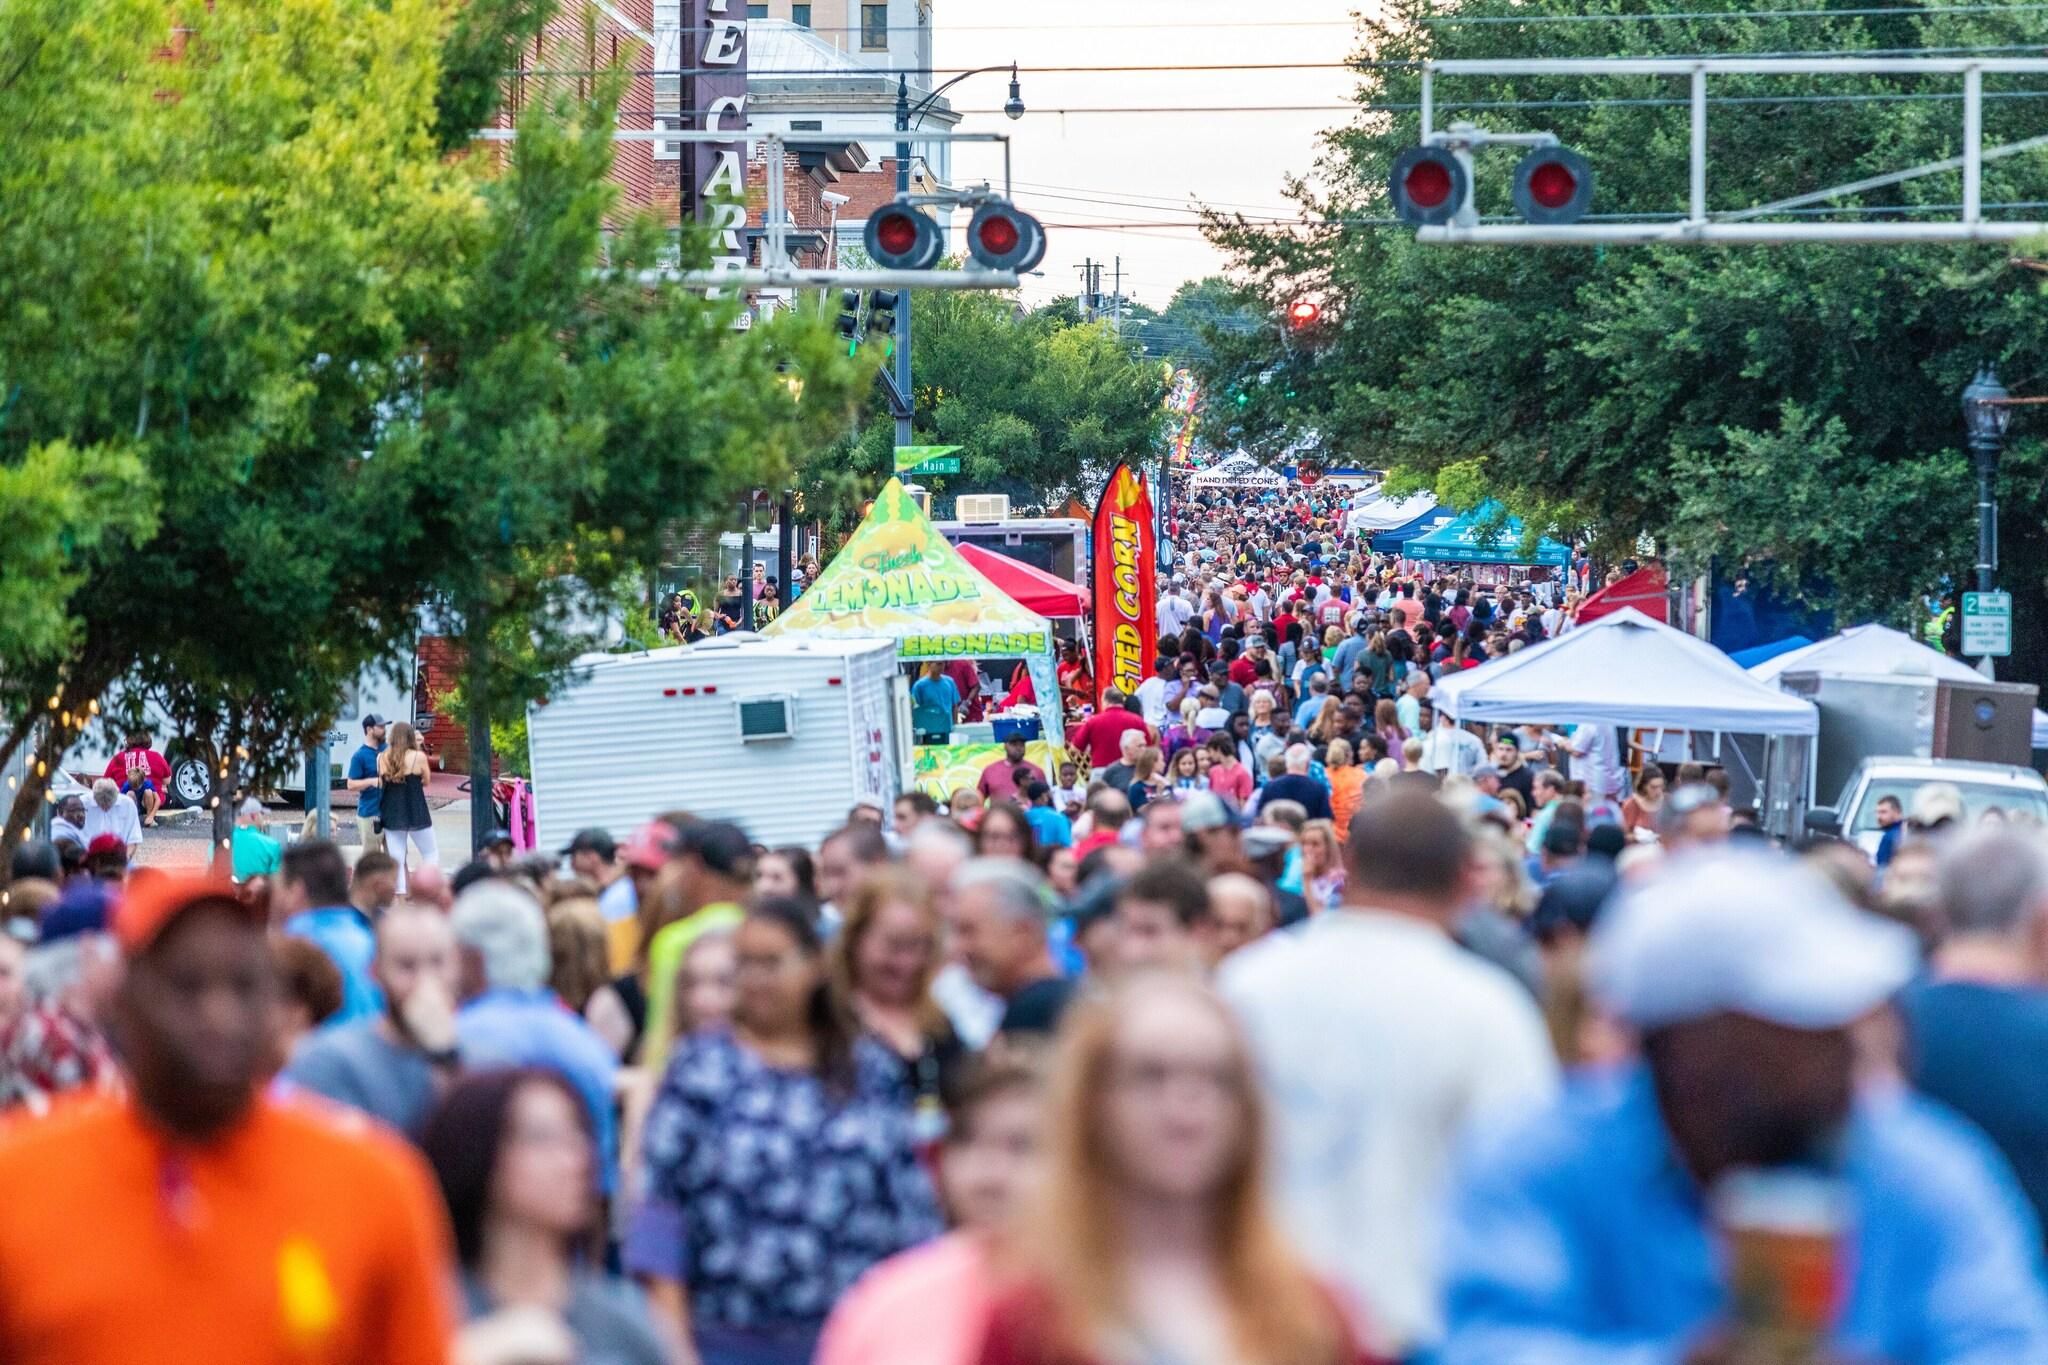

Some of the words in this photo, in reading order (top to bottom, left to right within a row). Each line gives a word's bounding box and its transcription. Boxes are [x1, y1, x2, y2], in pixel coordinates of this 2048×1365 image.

[923, 459, 945, 471] Main
[1196, 476, 1220, 484] HAND
[1251, 477, 1279, 485] CONES
[1111, 513, 1142, 620] CORN
[811, 572, 980, 611] LEMONADE
[1967, 598, 1977, 612] 2
[898, 631, 1047, 657] EMONADE
[1112, 622, 1142, 697] STED
